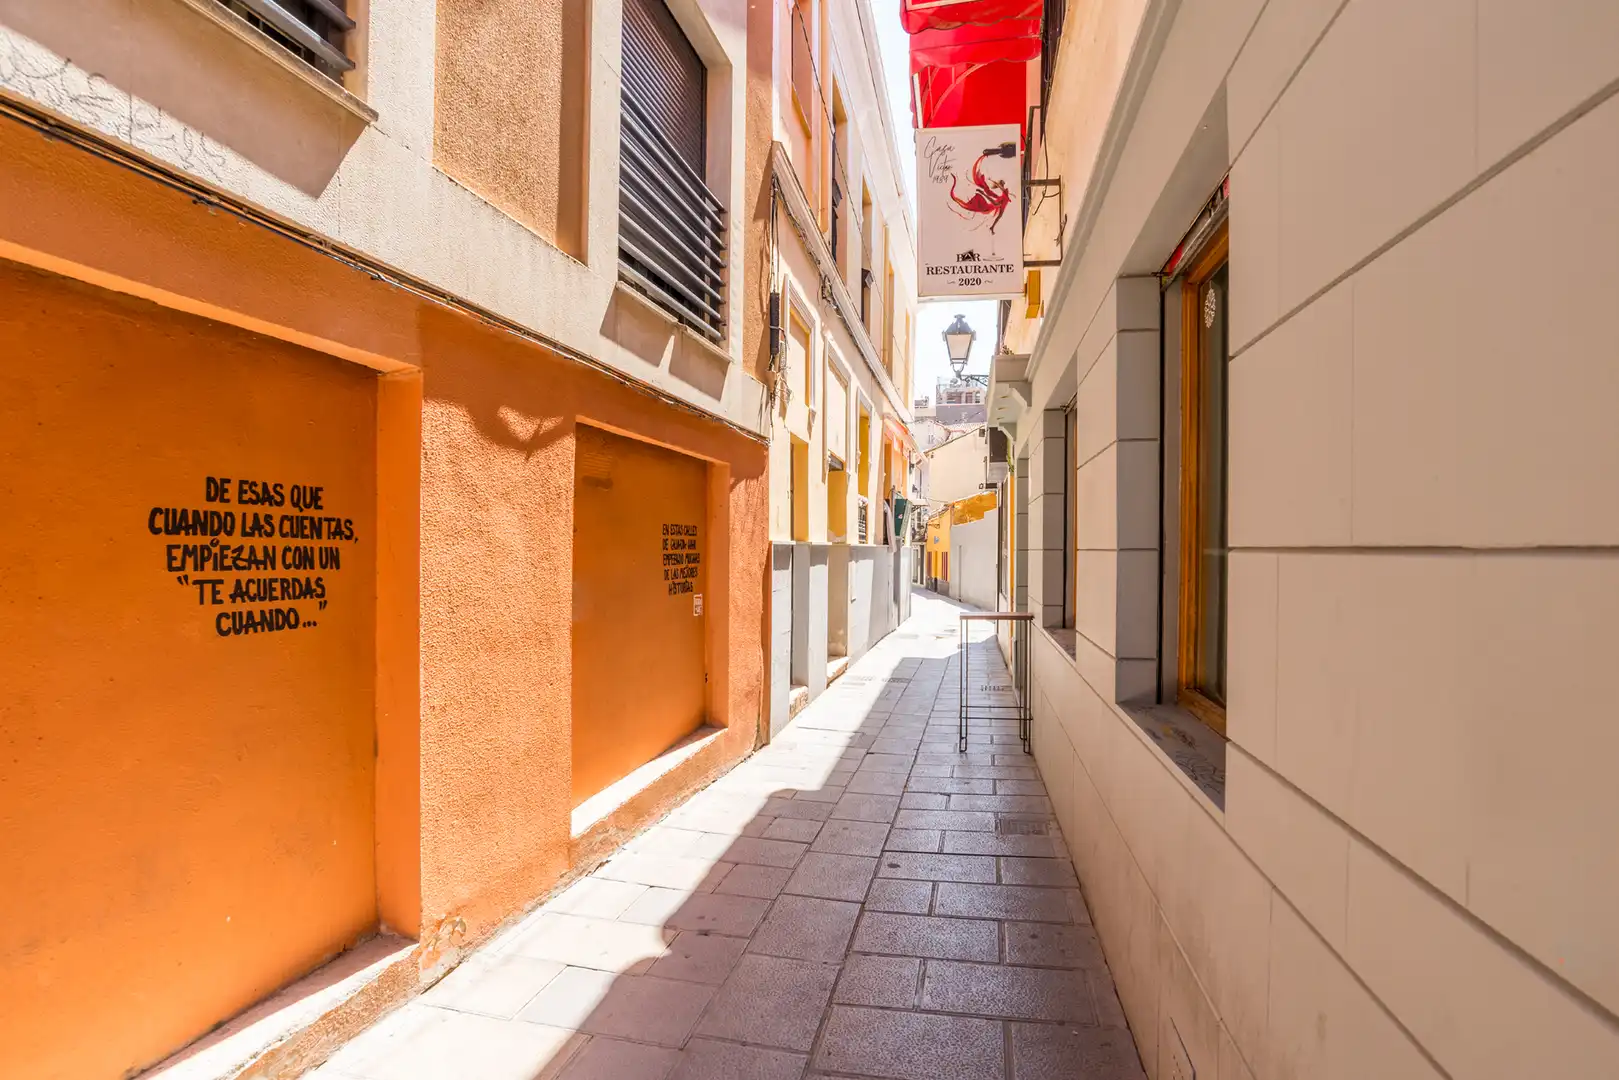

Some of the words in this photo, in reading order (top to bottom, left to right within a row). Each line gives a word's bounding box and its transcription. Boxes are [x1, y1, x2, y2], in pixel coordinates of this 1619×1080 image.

[923, 135, 956, 158] Casa
[956, 252, 981, 262] BAR
[926, 263, 1015, 276] RESTAURANTE
[958, 277, 982, 287] 2020
[205, 476, 232, 504] DE
[238, 479, 285, 507] ESAS
[290, 485, 324, 513] QUE
[148, 507, 235, 537] CUANDO
[241, 512, 275, 538] LAS
[279, 514, 359, 543] CUENTAS,
[662, 524, 669, 536] EN
[670, 524, 683, 536] ESTAS
[663, 539, 669, 551] DE
[281, 545, 315, 571] CON
[319, 546, 340, 570] UN
[664, 568, 669, 580] DE
[670, 567, 679, 580] LAS
[229, 577, 326, 604] ACUERDAS
